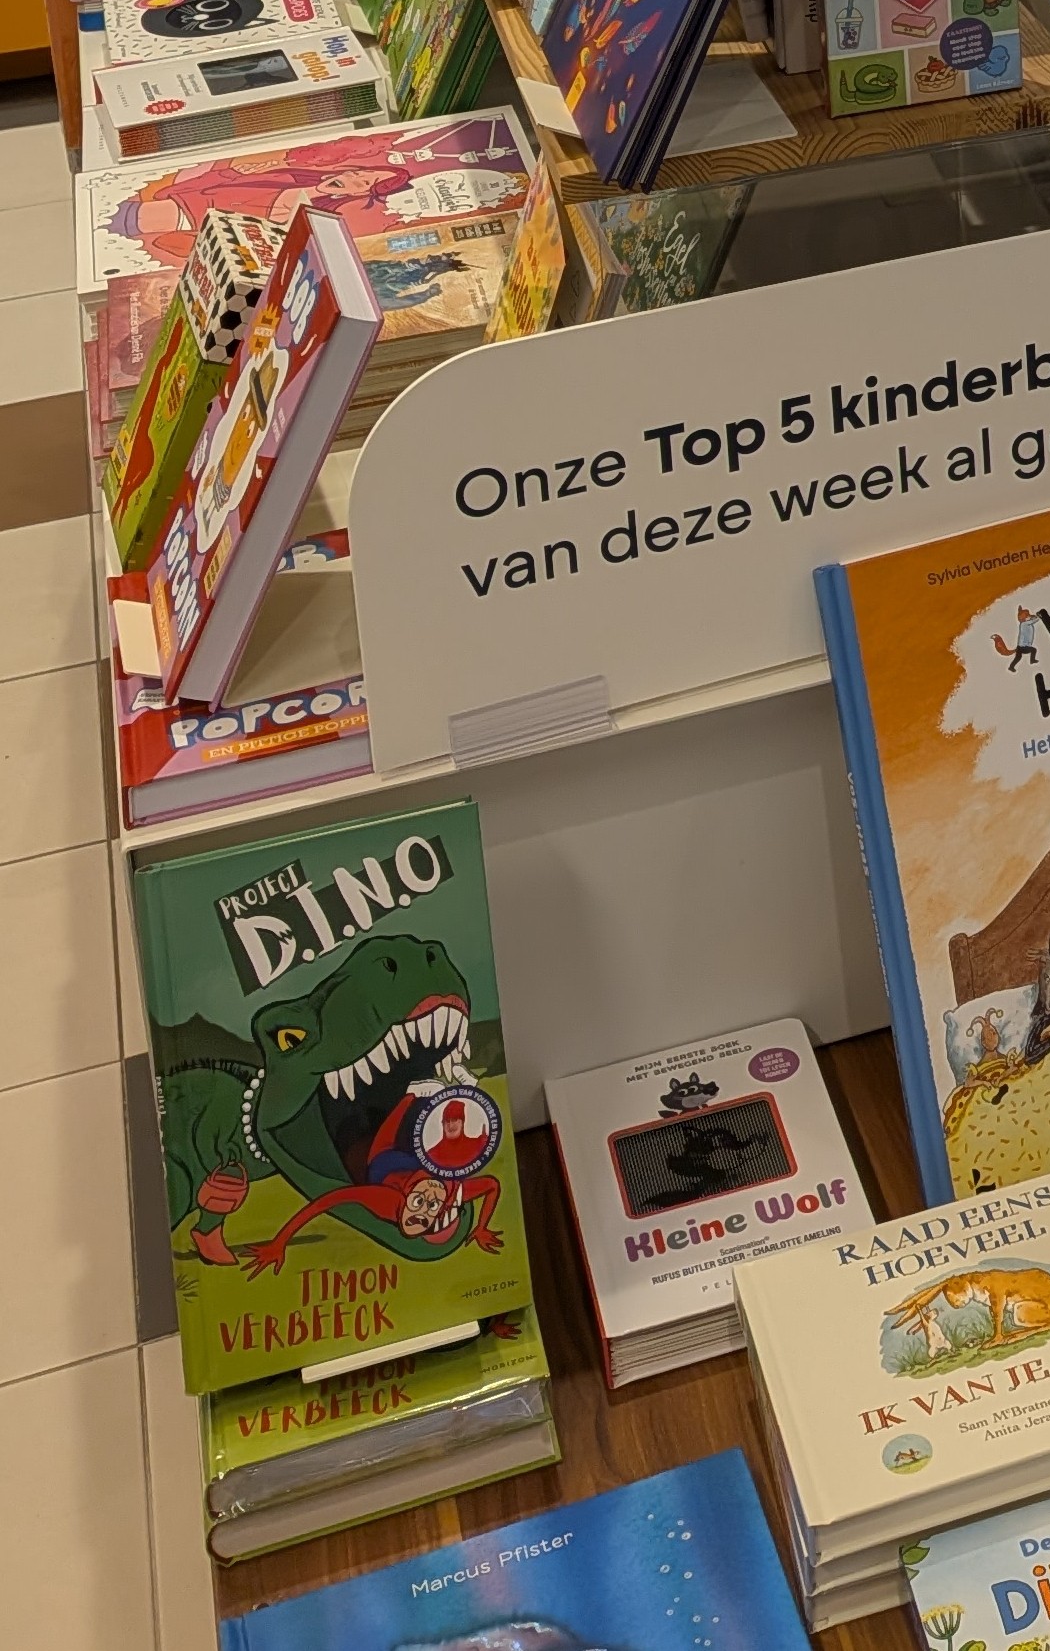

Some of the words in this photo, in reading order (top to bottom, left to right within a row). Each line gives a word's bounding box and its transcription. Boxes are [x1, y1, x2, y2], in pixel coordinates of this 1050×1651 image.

[452, 444, 628, 518] Onze
[643, 411, 766, 476] Top
[780, 393, 816, 445] 5
[459, 539, 580, 600] van
[597, 488, 753, 565] deze
[769, 444, 931, 524] week
[945, 428, 992, 482] al
[218, 861, 304, 921] PROJECT
[626, 1072, 650, 1084] MET
[653, 1054, 715, 1076] BEWEGEND
[719, 1044, 752, 1059] BEELD
[634, 1060, 662, 1073] MIJN
[666, 1049, 706, 1066] EERSTE
[710, 1040, 740, 1053] BOEK
[624, 1212, 748, 1262] Kleine
[754, 1178, 848, 1224] Wolf
[831, 1213, 952, 1269] RAAD
[652, 1270, 681, 1286] RUFUS
[682, 1260, 717, 1277] BUTLER
[717, 1252, 746, 1269] SEDER
[752, 1236, 802, 1257] CHARLOTTE
[803, 1225, 842, 1244] AMELING
[861, 1217, 1050, 1289] HOEVEEL
[298, 1262, 400, 1310] TIMON
[218, 1301, 396, 1354] VERBEECK
[856, 1399, 901, 1438] IK
[909, 1375, 992, 1423] VAN
[995, 1359, 1049, 1398] JE
[982, 1421, 1021, 1445] Anita
[408, 1559, 491, 1600] Marcus
[493, 1528, 576, 1579] Pfister
